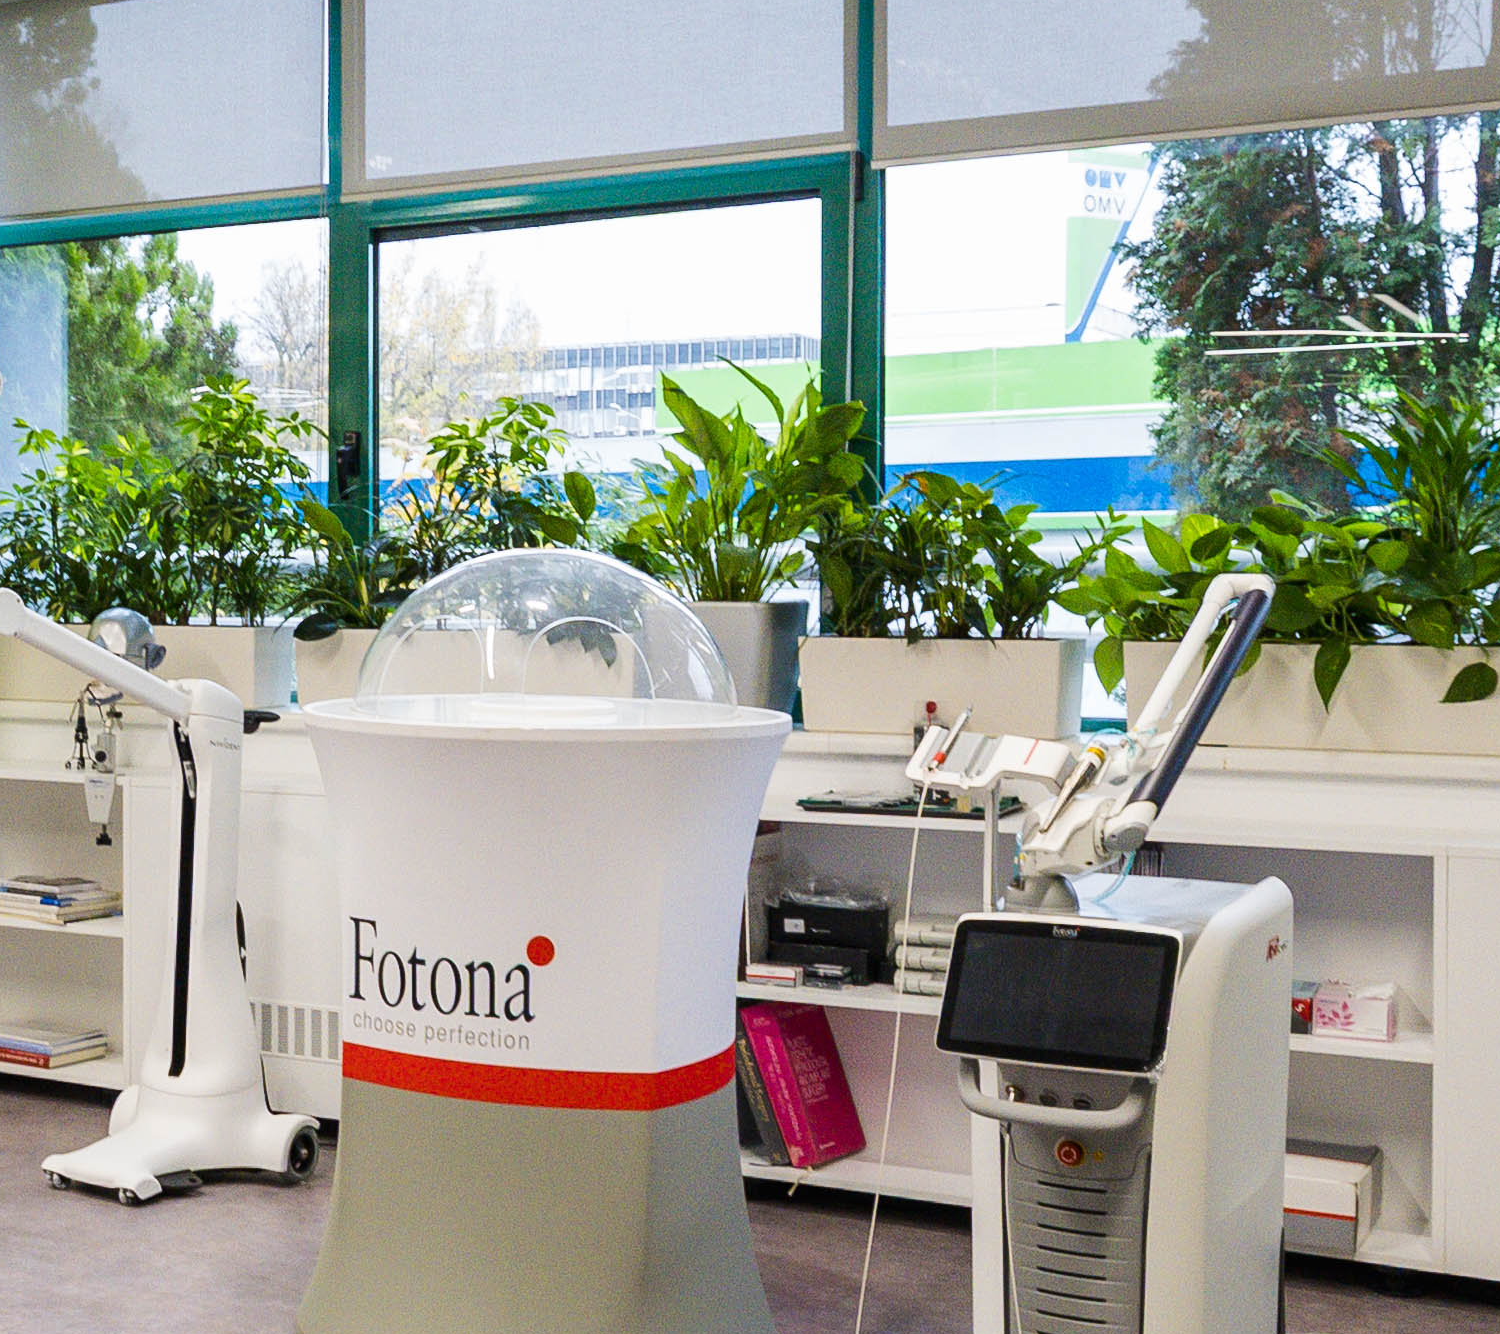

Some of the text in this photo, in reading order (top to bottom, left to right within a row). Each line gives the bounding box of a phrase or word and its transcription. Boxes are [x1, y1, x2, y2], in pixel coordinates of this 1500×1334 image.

[1083, 194, 1126, 214] OMV
[349, 916, 536, 1023] Fotona
[352, 1010, 530, 1051] choose perfection
